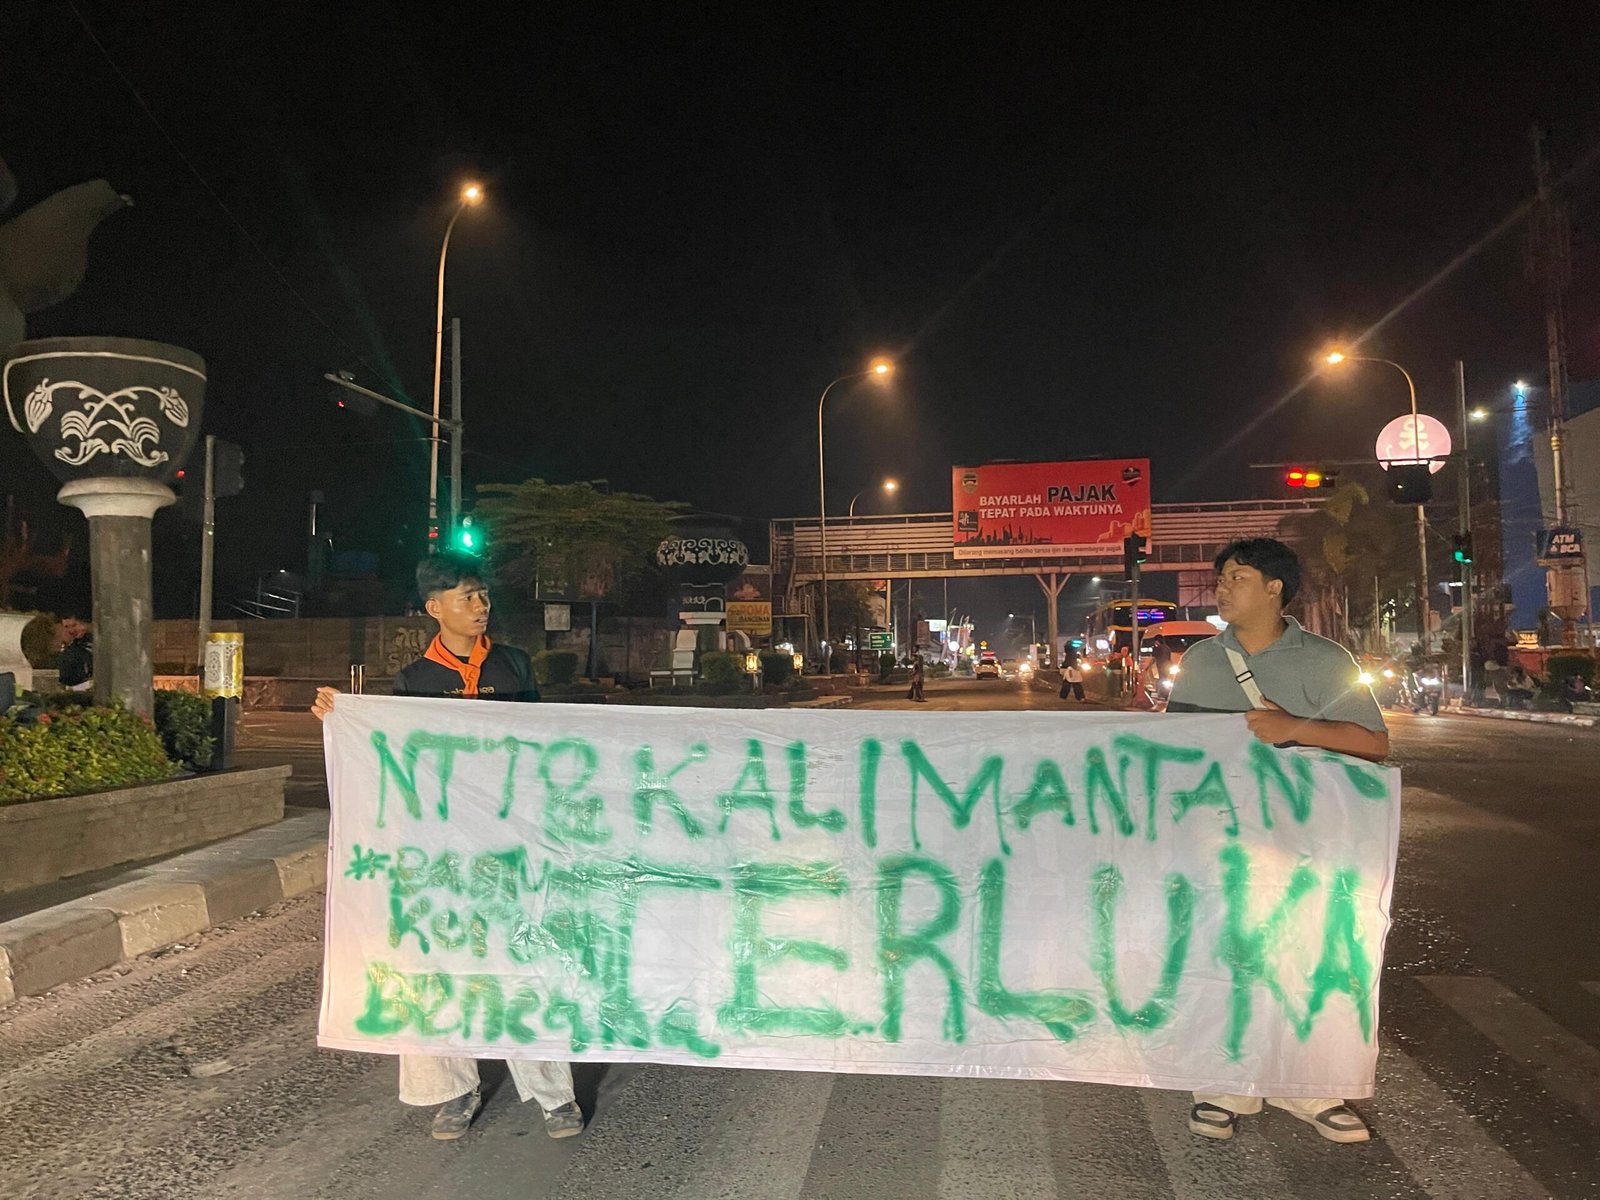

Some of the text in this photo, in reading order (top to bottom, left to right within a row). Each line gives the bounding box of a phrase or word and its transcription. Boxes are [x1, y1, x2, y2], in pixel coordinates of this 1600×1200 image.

[979, 484, 1116, 506] BAYARLAH PAJAK
[979, 504, 1123, 518] TEPAT PADA WAKTUNYA
[1551, 534, 1575, 543] ATM
[370, 731, 543, 830] NTT
[636, 731, 1316, 853] KALIMANTAN
